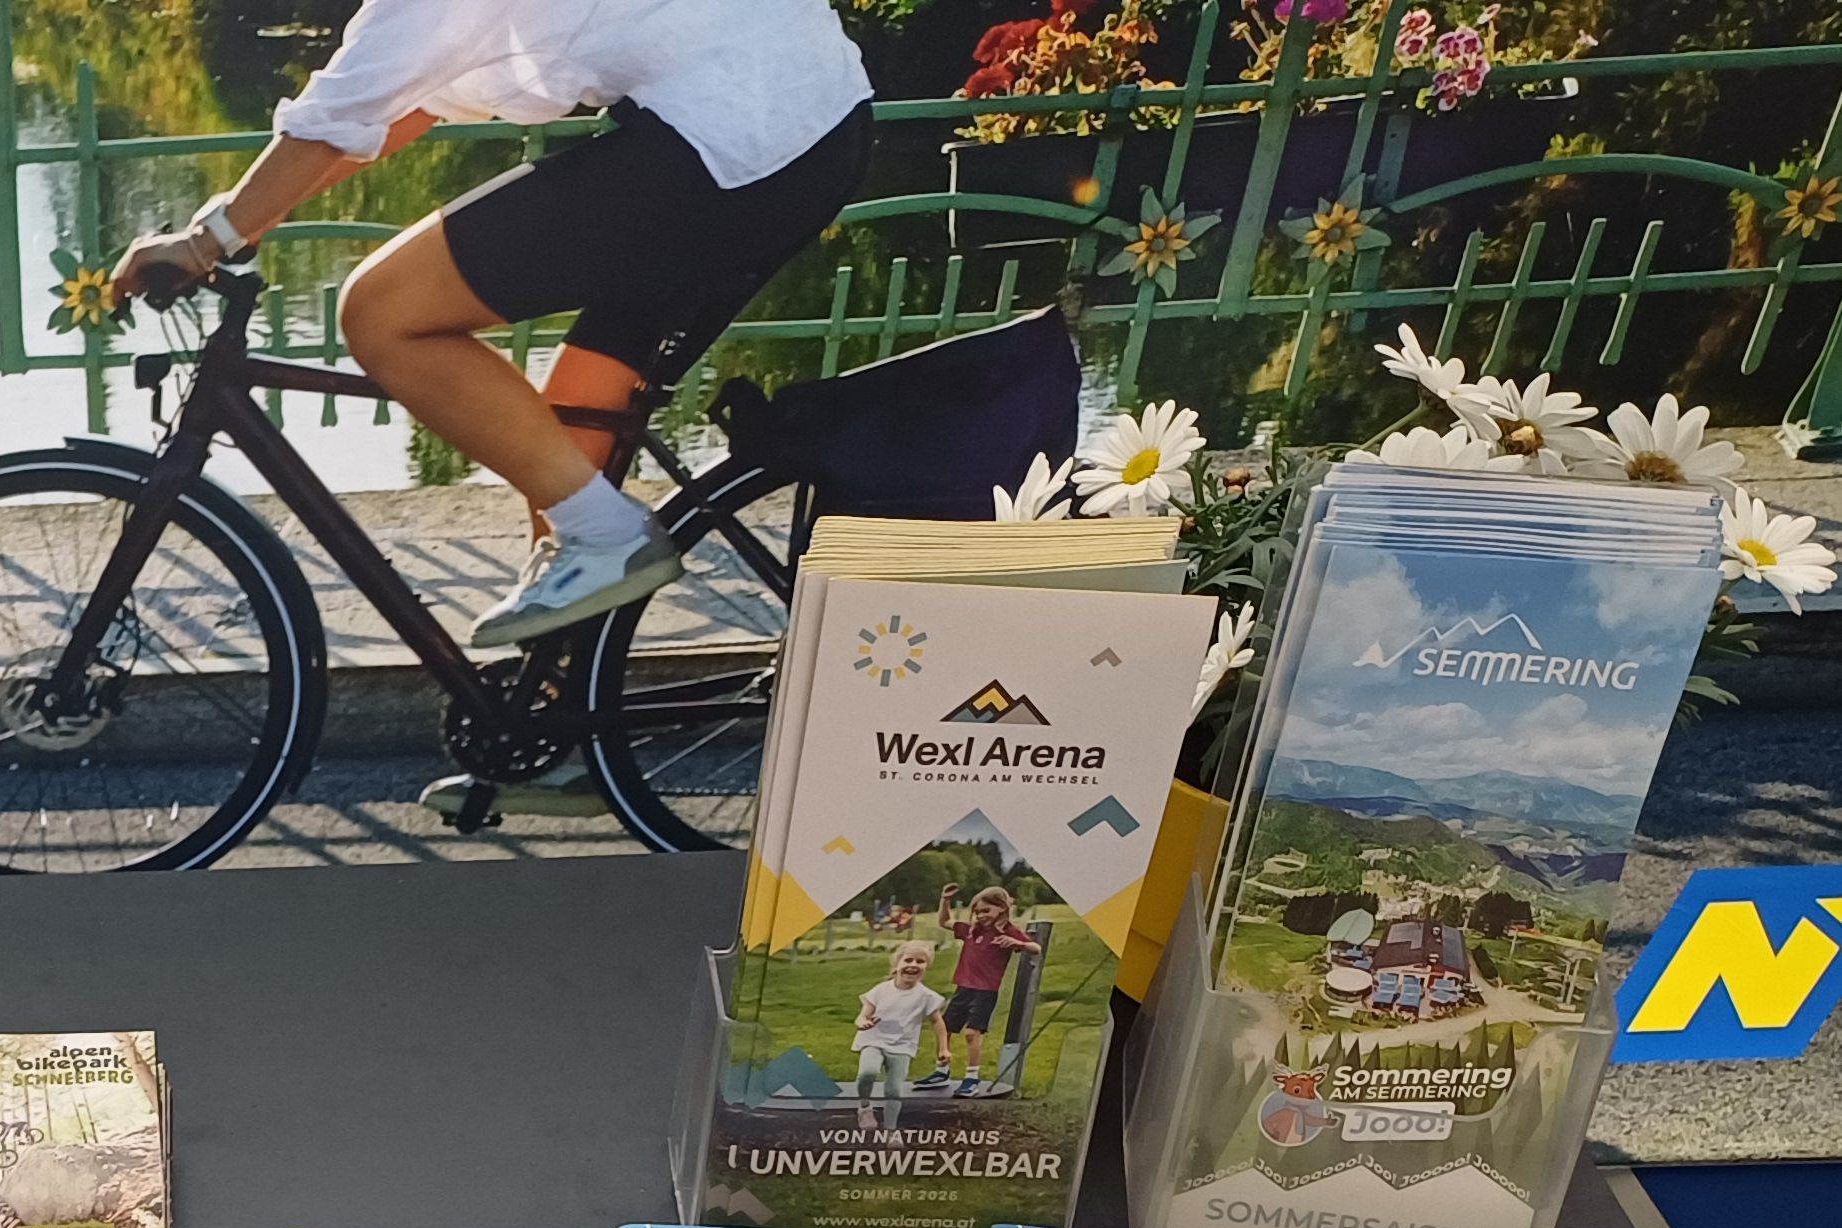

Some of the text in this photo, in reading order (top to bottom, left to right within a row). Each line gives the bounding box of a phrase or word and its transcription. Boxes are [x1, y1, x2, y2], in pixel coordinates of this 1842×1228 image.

[1413, 647, 1639, 690] SEMMERING
[876, 732, 1106, 769] Wexl Arena
[879, 770, 1100, 786] ST. CORONA AM WECHSEL
[1627, 901, 1840, 1033] N
[50, 1046, 112, 1060] alpen
[17, 1055, 128, 1073] bikepark
[13, 1069, 134, 1087] SCHNEEBERG
[1332, 1063, 1516, 1091] Sommering
[1330, 1083, 1487, 1100] AM SEMMERING
[1350, 1110, 1448, 1138] Jooo!
[819, 1129, 1000, 1145] VON NATUR AUS
[750, 1150, 1062, 1179] UNVERWEXLBAR
[839, 1189, 959, 1202] SOMMER 2026
